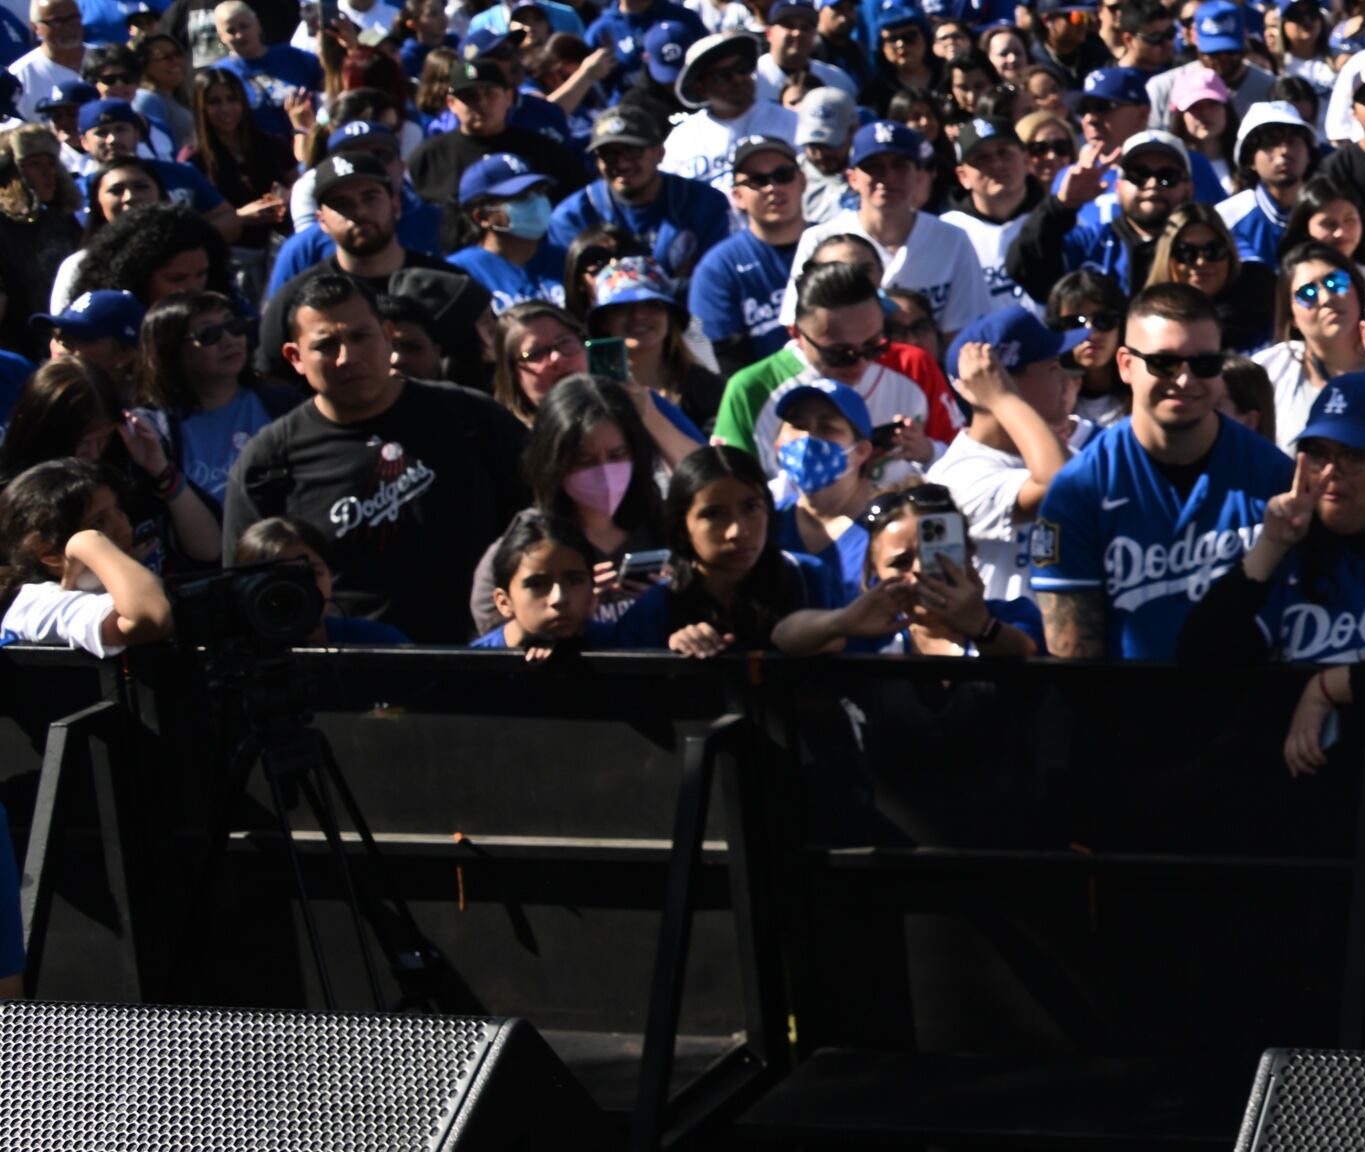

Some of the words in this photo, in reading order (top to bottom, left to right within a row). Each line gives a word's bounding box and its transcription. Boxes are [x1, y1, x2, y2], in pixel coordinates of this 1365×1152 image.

[1324, 387, 1347, 414] LA
[330, 461, 438, 538] Dodgers
[1107, 521, 1267, 603] Dodger
